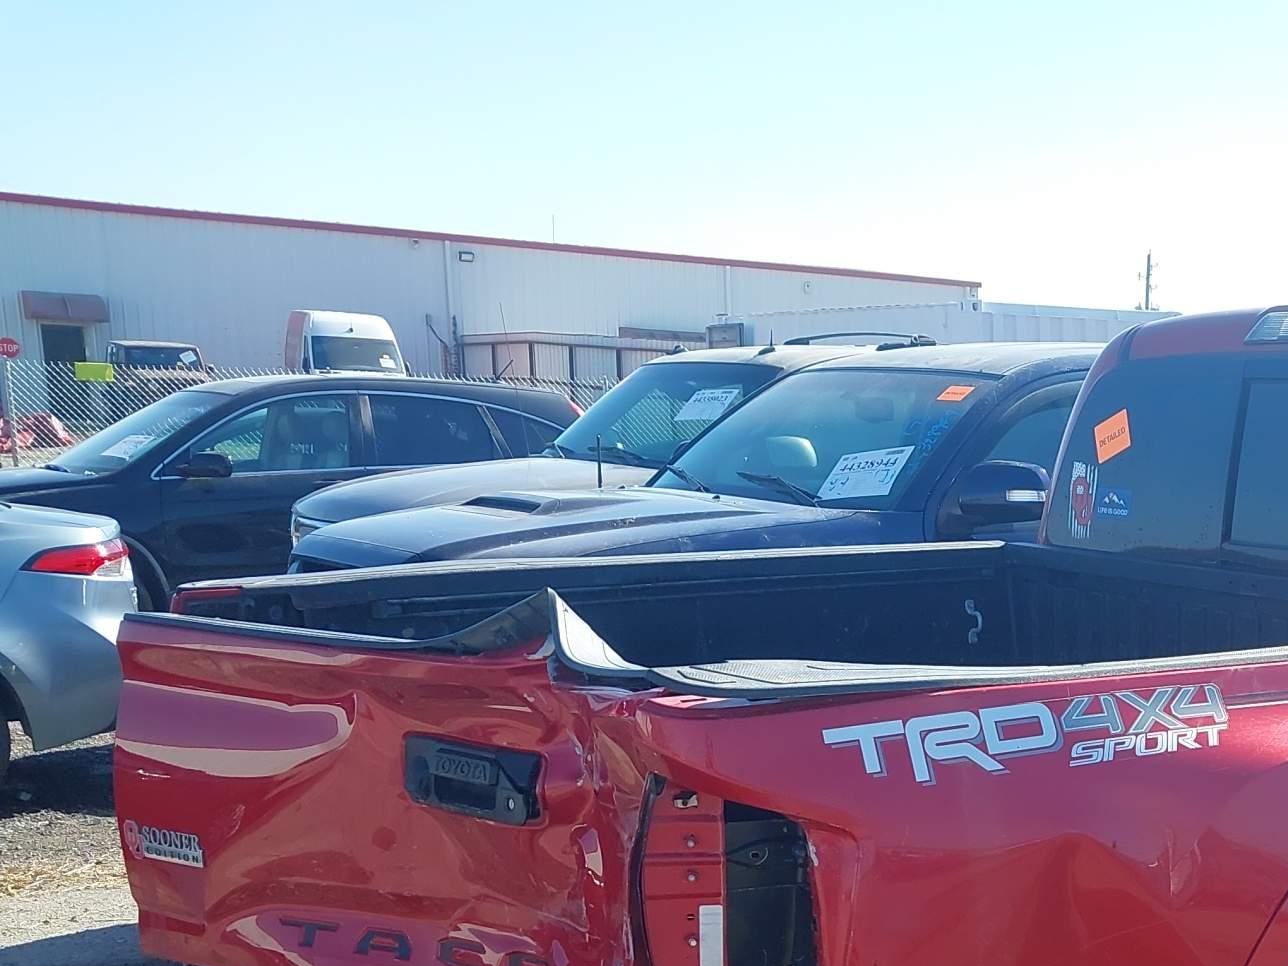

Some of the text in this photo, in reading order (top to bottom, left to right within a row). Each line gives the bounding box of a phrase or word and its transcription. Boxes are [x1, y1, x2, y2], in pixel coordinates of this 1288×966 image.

[1099, 426, 1126, 448] DETAILED
[1097, 506, 1107, 514] LIFE
[1112, 508, 1128, 516] GOOD
[821, 700, 1064, 786] TRD
[1068, 724, 1229, 768] SPORT
[434, 755, 487, 781] TOYOTA
[142, 826, 200, 853] SOONER
[146, 845, 200, 864] EDITION
